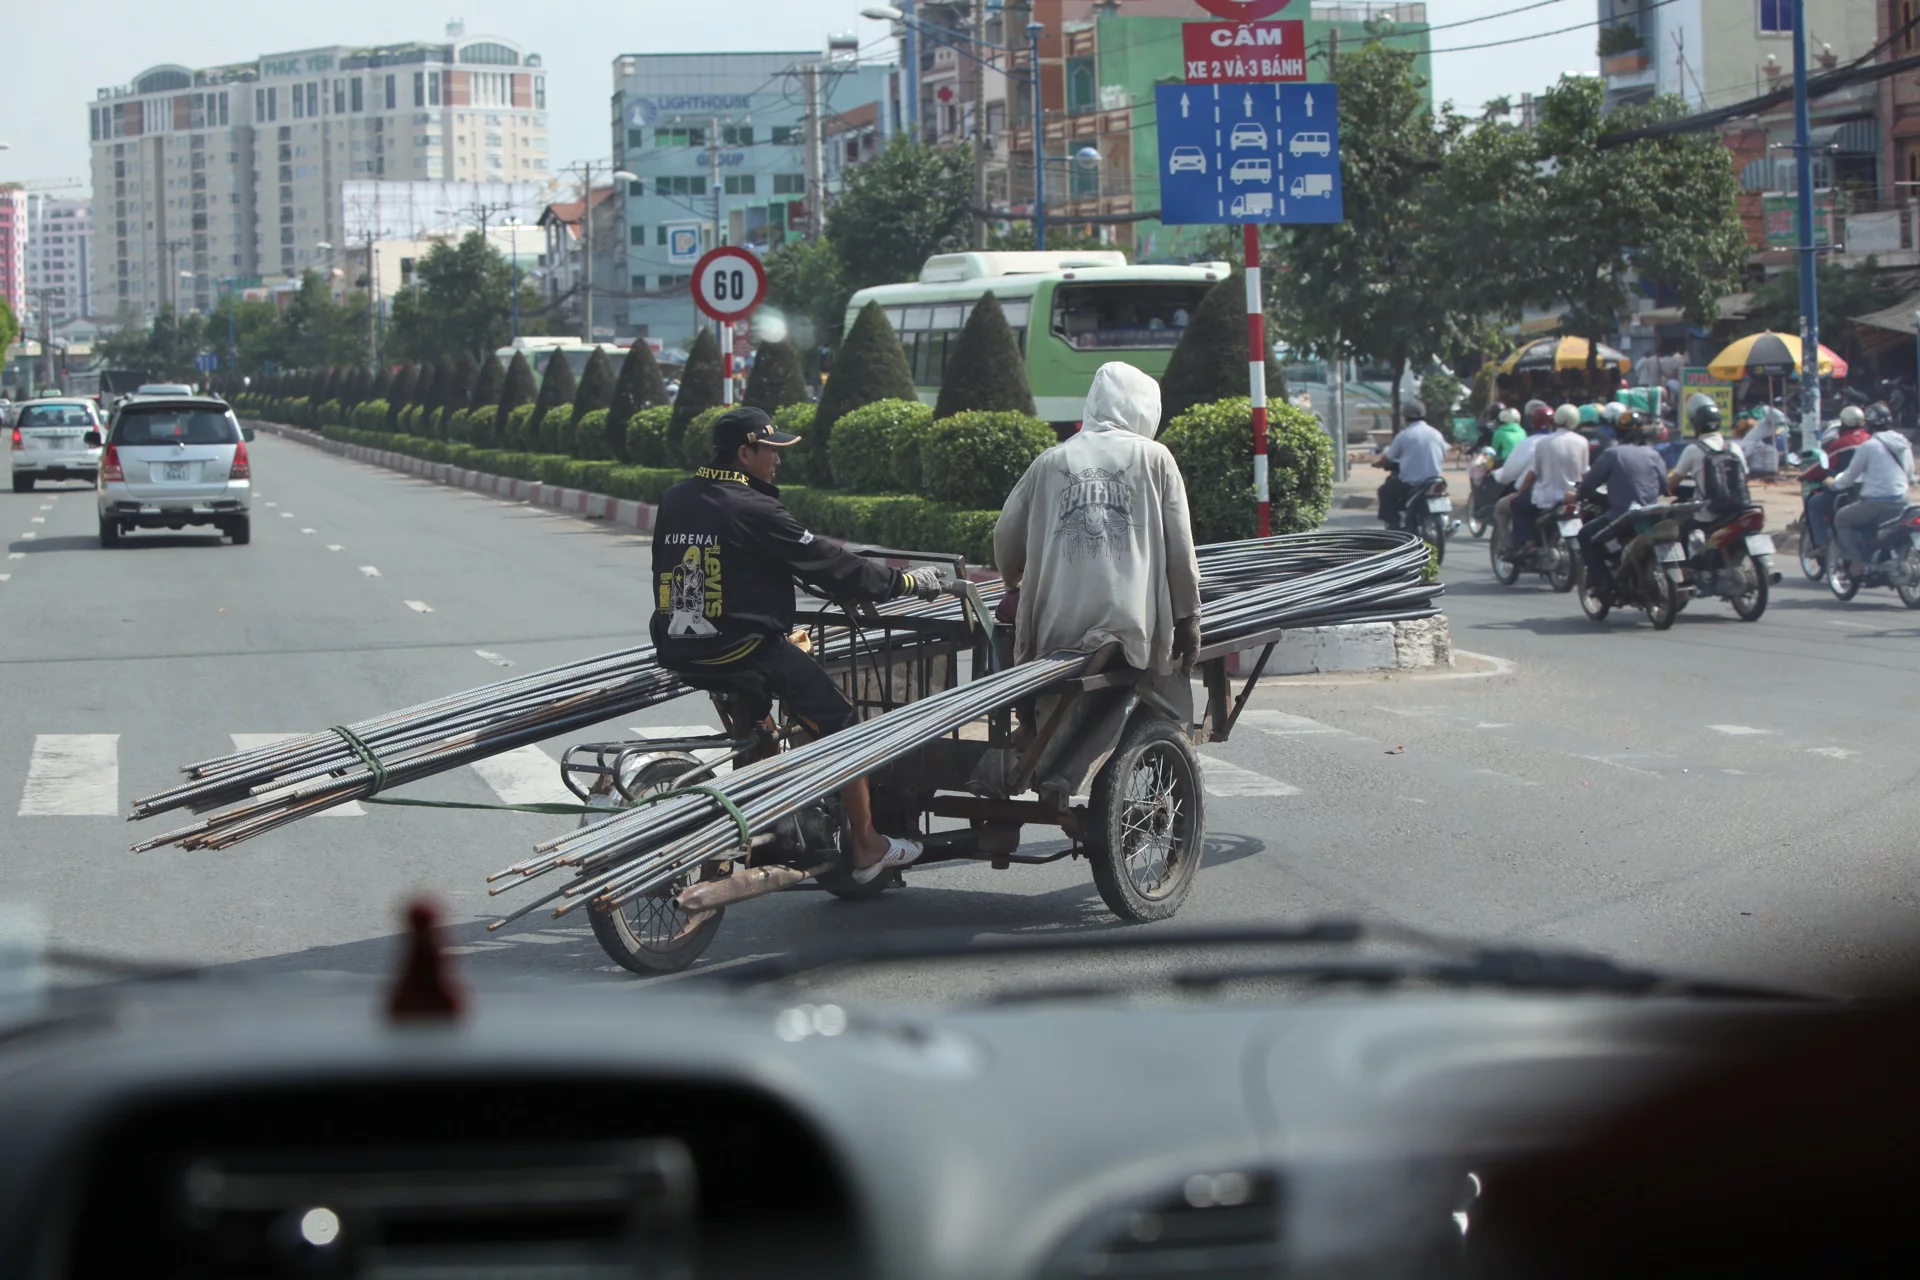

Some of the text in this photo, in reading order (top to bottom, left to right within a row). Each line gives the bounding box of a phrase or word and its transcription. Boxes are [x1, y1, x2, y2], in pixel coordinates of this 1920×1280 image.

[1211, 23, 1282, 47] CẤM
[1188, 54, 1303, 79] XE 2 VÀ 3 BÁNH
[658, 96, 752, 109] LIGHTHOUSE
[714, 270, 744, 301] 60
[665, 534, 718, 545] KURENAI
